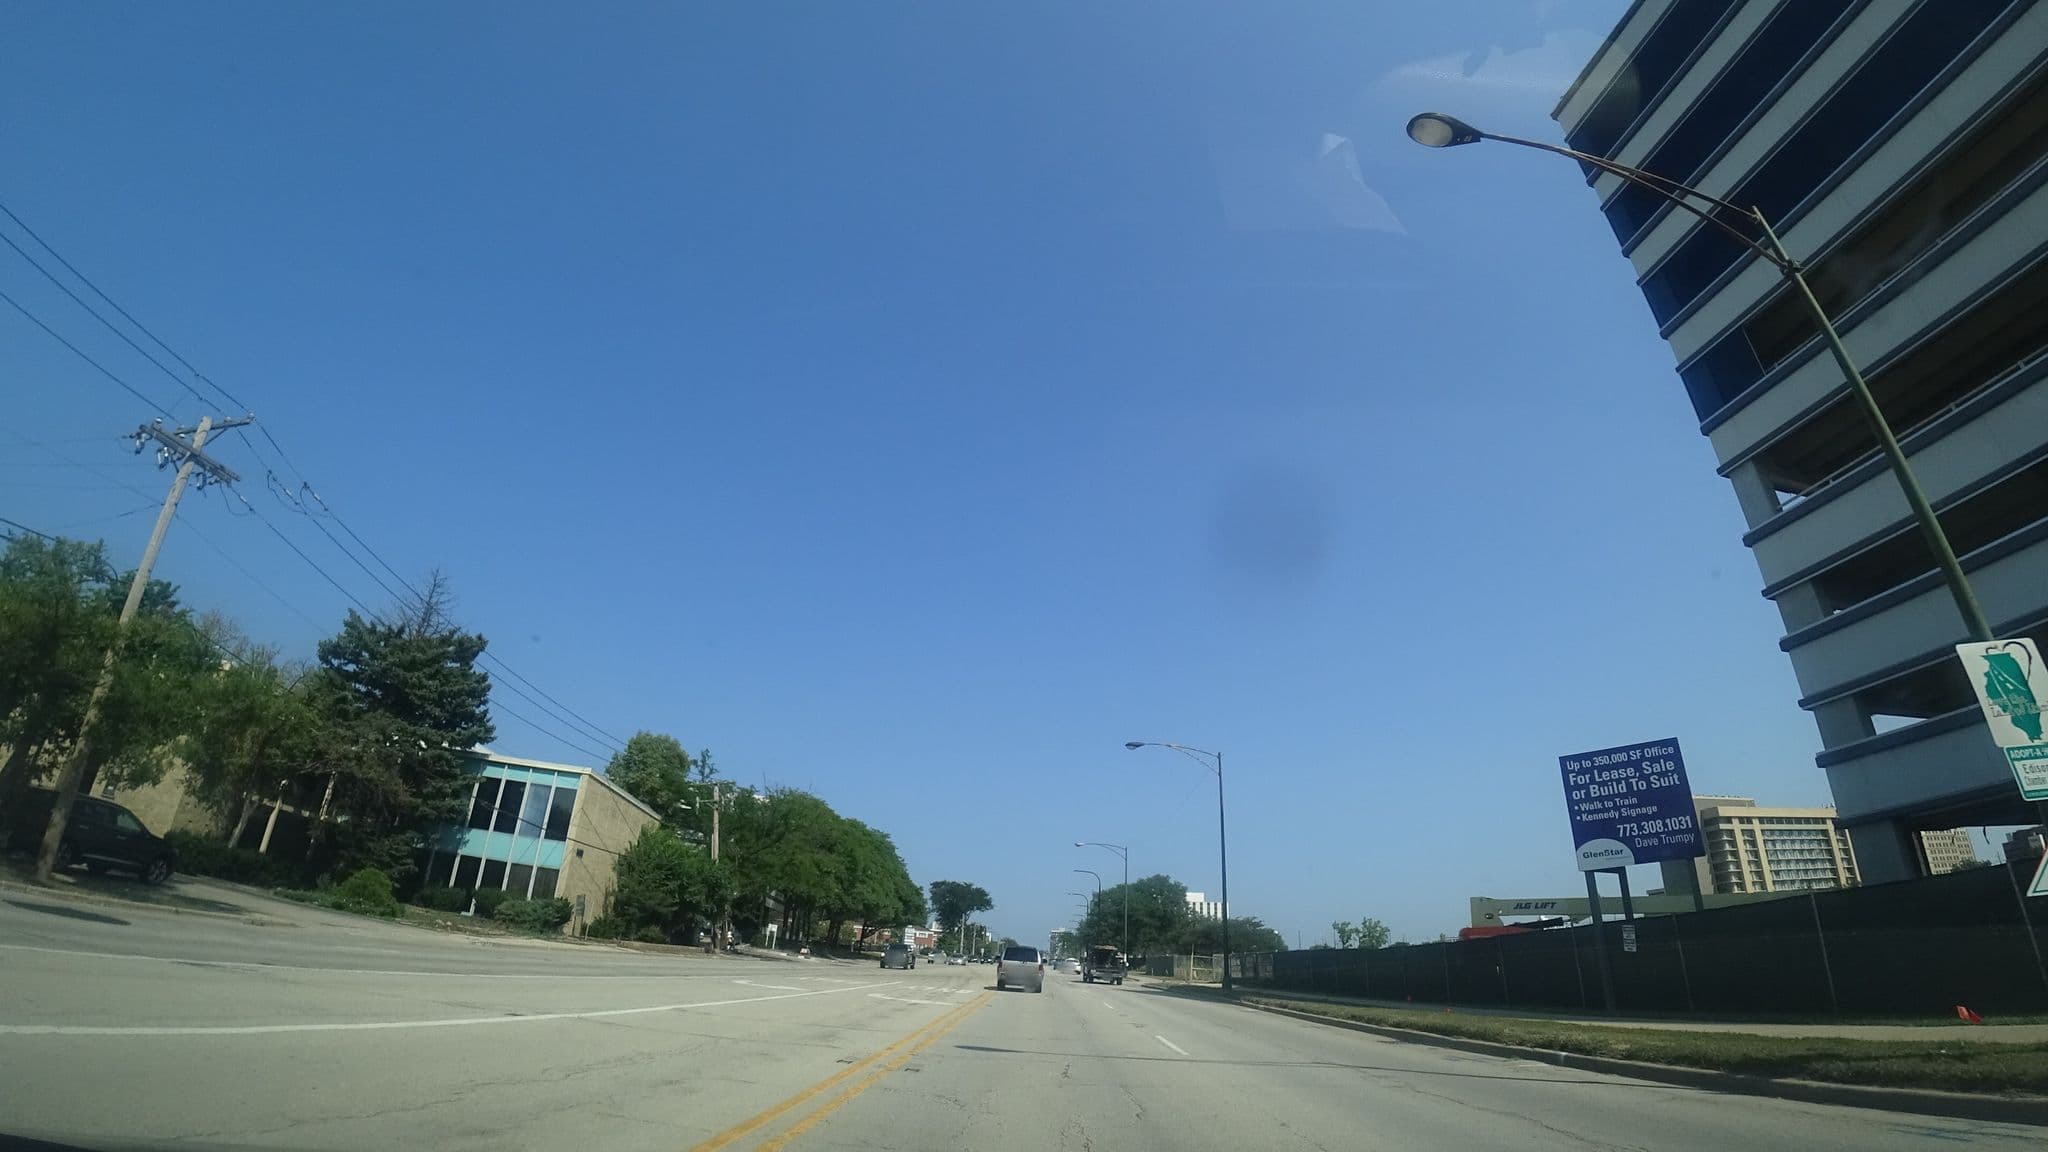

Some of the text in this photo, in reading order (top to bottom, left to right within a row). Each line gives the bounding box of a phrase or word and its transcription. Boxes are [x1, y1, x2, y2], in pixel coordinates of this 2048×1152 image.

[1566, 746, 1675, 771] Up to 350,000 SF Office
[1569, 759, 1675, 785] For Lease, Sale
[1572, 773, 1680, 800] or Build To Suit
[1579, 796, 1638, 812] Walk to Train
[1582, 805, 1658, 821] Kennedy Signage
[1616, 815, 1693, 837] 773.308.1031
[1635, 833, 1695, 848] Dave Trumpy
[1582, 848, 1625, 859] GlenStar
[1513, 902, 1532, 910] JLG
